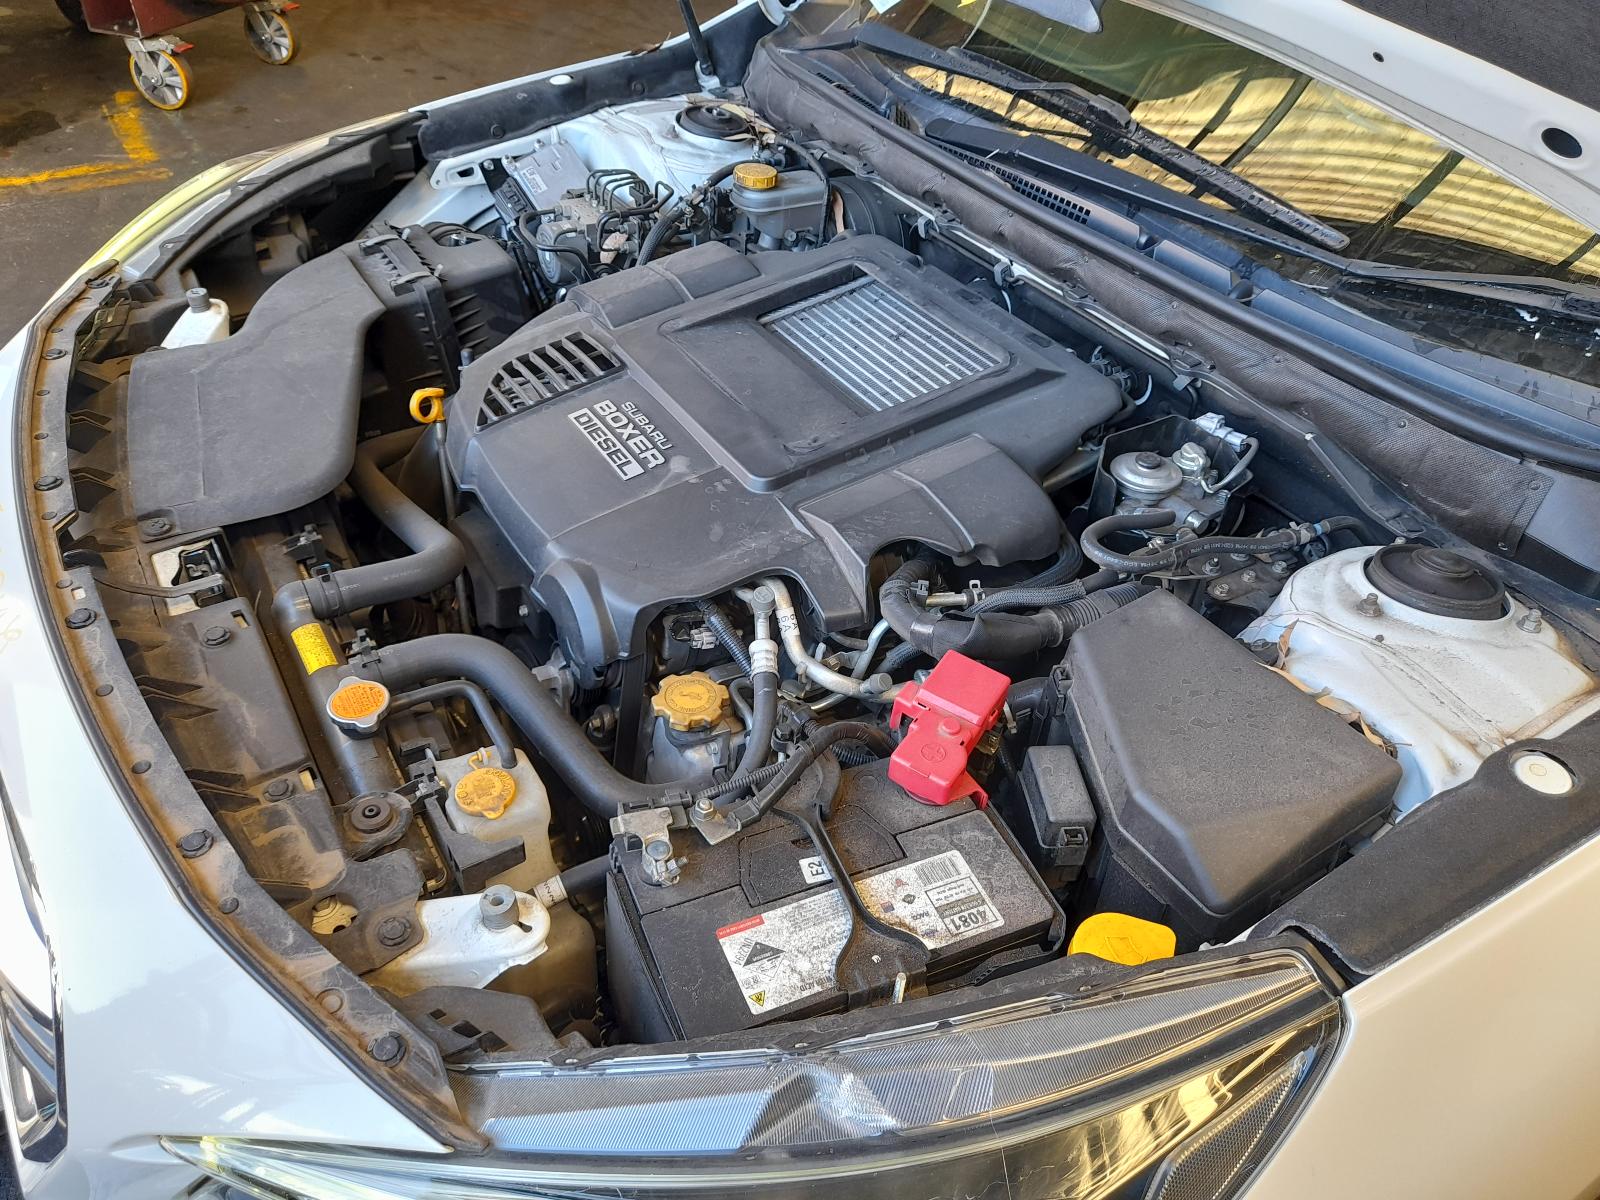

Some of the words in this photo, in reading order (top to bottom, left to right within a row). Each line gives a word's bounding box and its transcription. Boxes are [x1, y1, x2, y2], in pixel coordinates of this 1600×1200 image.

[573, 411, 635, 478] DIESEL
[593, 399, 667, 470] BOXER
[621, 401, 674, 450] SUBARU
[807, 860, 826, 877] E2
[953, 909, 987, 932] 4081
[734, 937, 754, 966] UN2794
